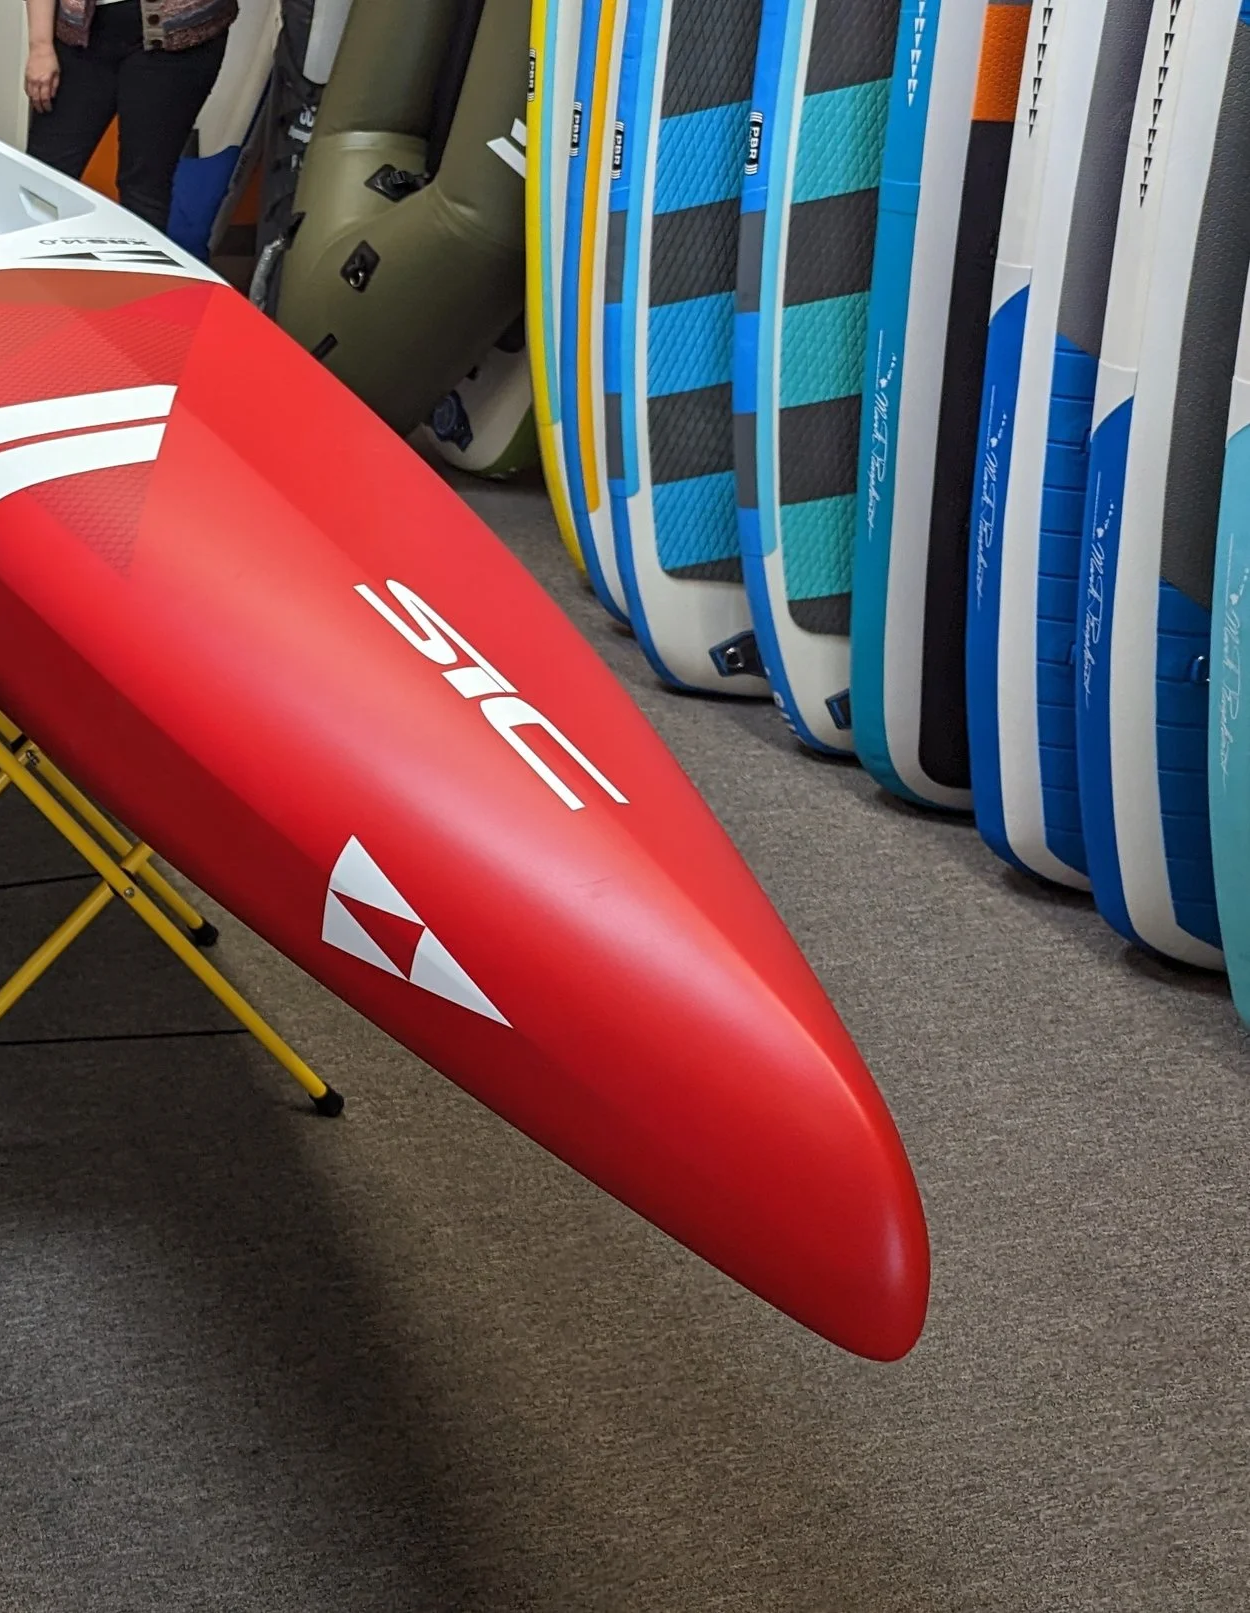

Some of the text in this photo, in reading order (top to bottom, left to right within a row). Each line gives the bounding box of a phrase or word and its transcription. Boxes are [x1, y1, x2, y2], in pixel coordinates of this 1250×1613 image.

[572, 114, 580, 143] PBR
[749, 126, 760, 159] PBR
[613, 134, 623, 165] PBR
[353, 579, 631, 812] SIC
